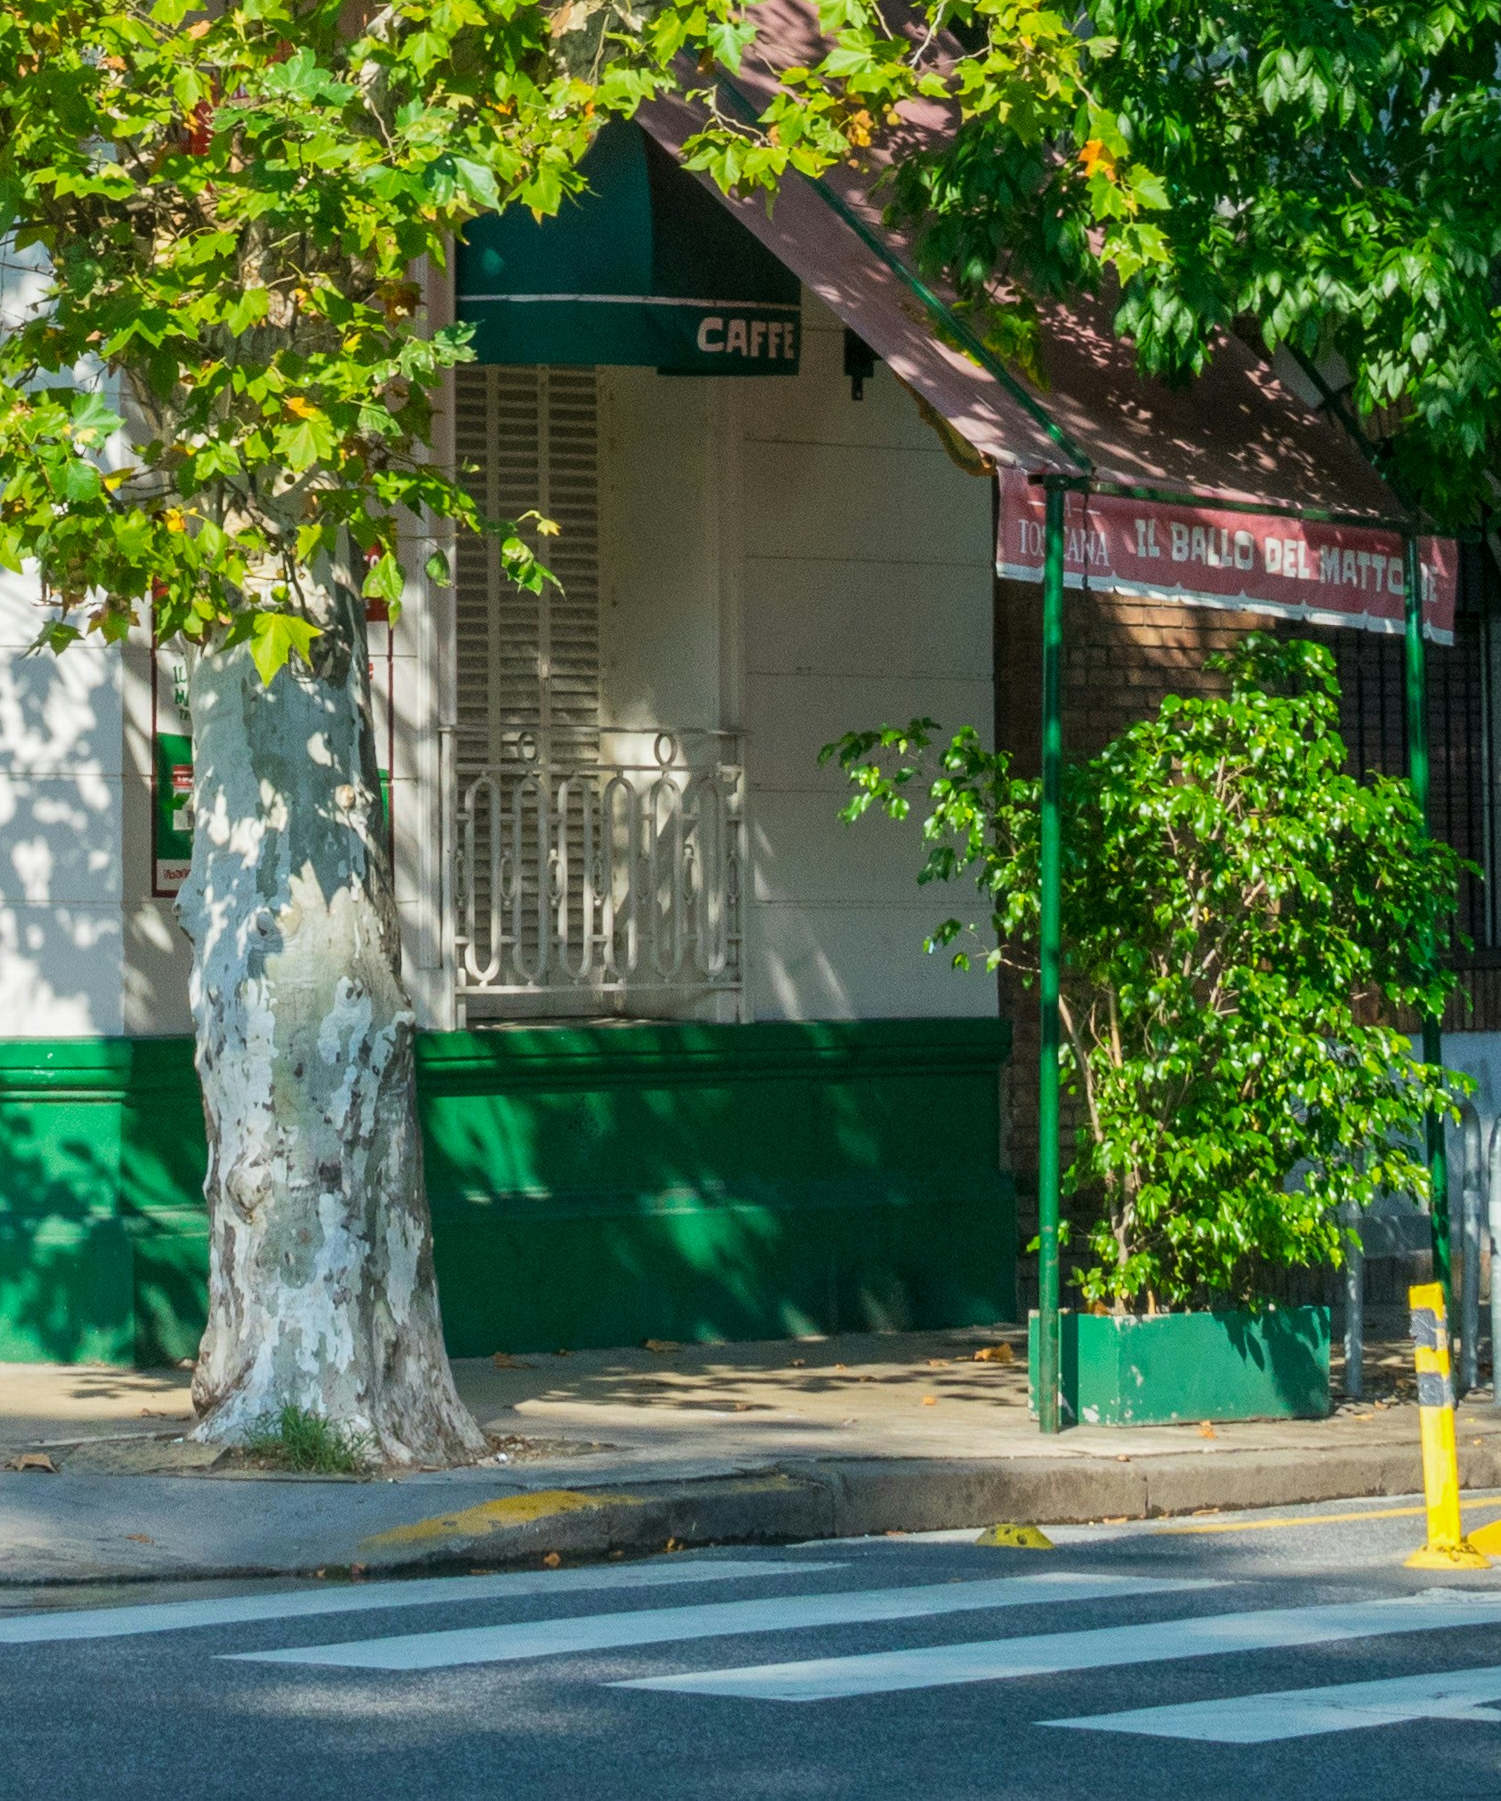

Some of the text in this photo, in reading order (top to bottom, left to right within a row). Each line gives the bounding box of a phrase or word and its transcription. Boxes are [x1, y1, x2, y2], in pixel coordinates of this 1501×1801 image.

[1017, 518, 1110, 568] TOANA
[1134, 518, 1161, 558] IL
[1170, 521, 1255, 571] BALLO
[1264, 536, 1311, 580] DEL
